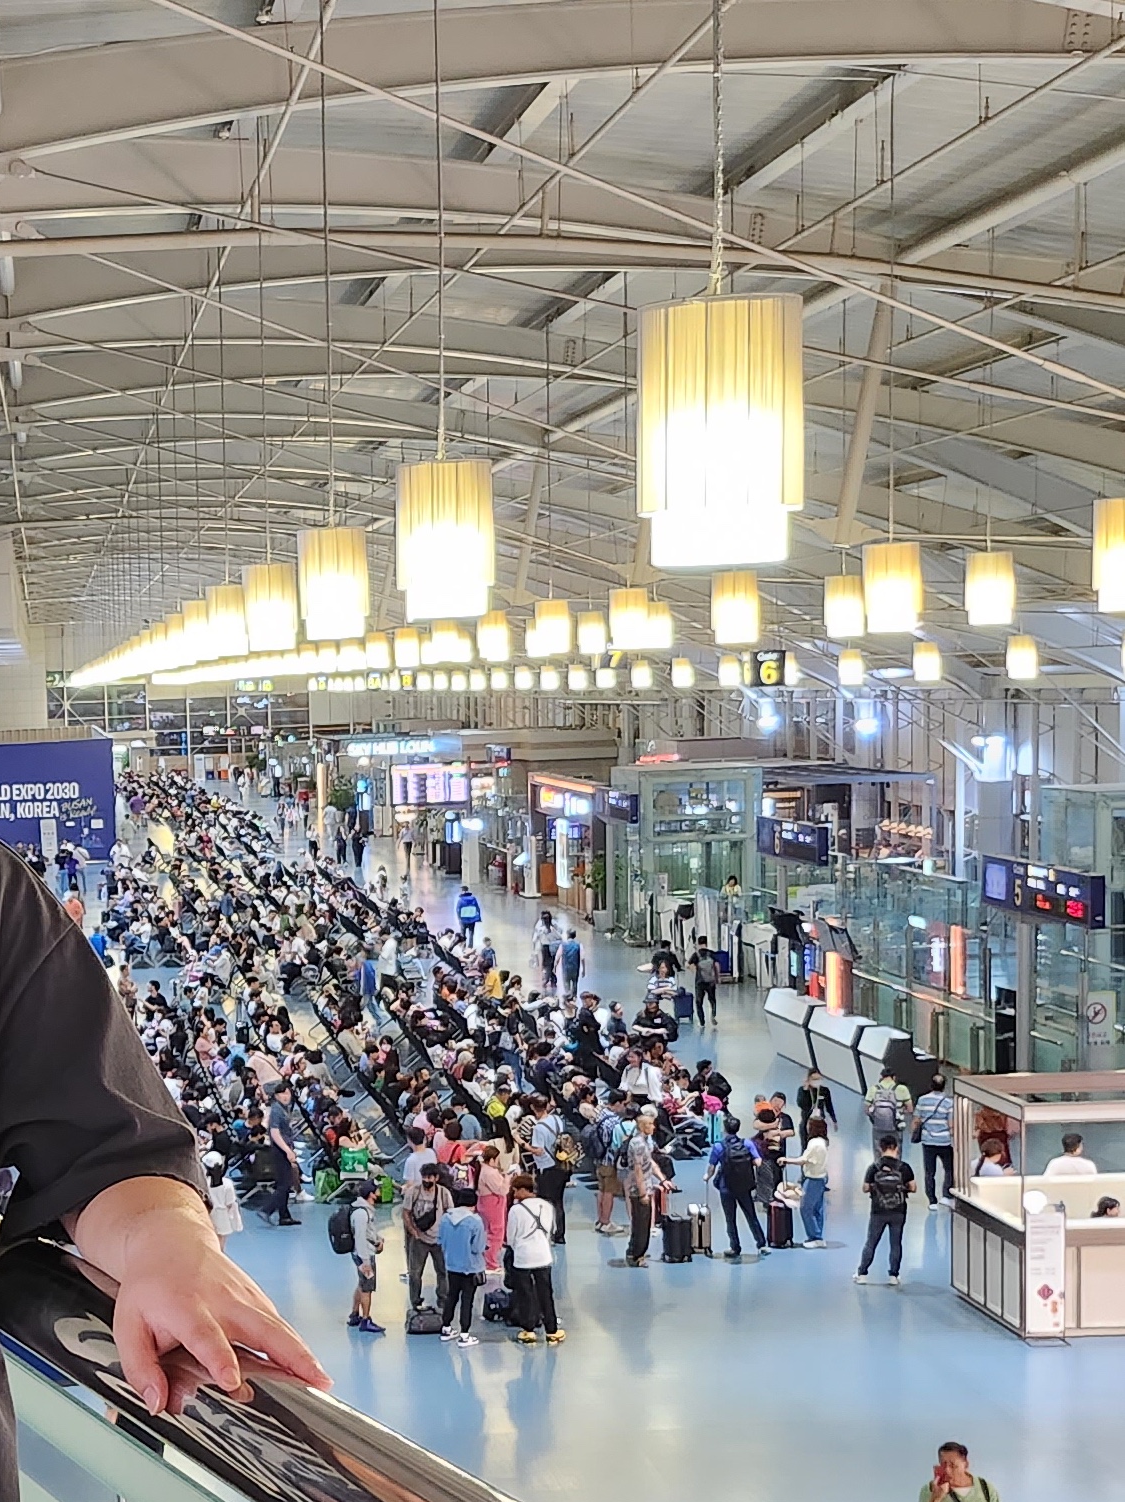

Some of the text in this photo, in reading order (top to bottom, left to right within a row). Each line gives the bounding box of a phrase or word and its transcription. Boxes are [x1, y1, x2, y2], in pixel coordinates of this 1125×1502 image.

[759, 660, 779, 685] 6
[12, 782, 44, 800] EXPO
[46, 782, 79, 799] 2030
[17, 801, 60, 819] KOREA
[1014, 878, 1022, 907] 5
